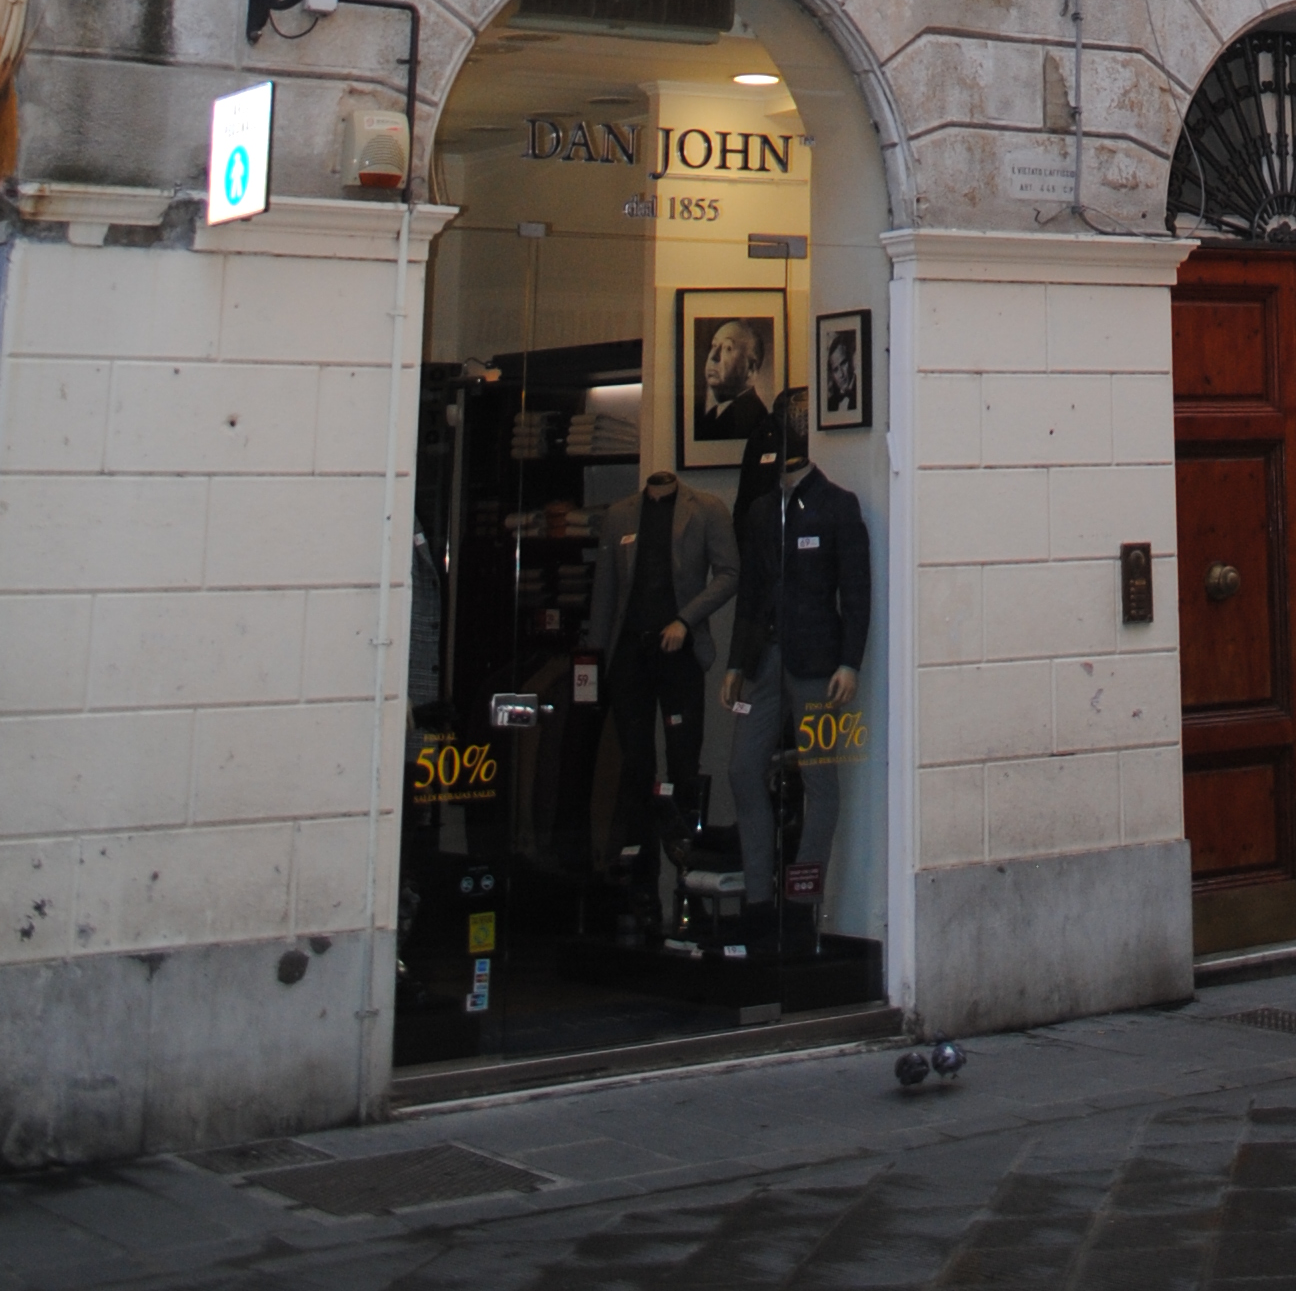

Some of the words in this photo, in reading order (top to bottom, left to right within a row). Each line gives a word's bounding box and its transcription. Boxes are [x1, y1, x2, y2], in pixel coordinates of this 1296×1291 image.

[522, 118, 640, 165] DAN
[649, 127, 793, 179] JOHN
[624, 194, 657, 218] dal
[668, 196, 720, 222] 1855
[576, 674, 589, 687] 59
[797, 710, 868, 753] 50%
[413, 742, 498, 789] 50%
